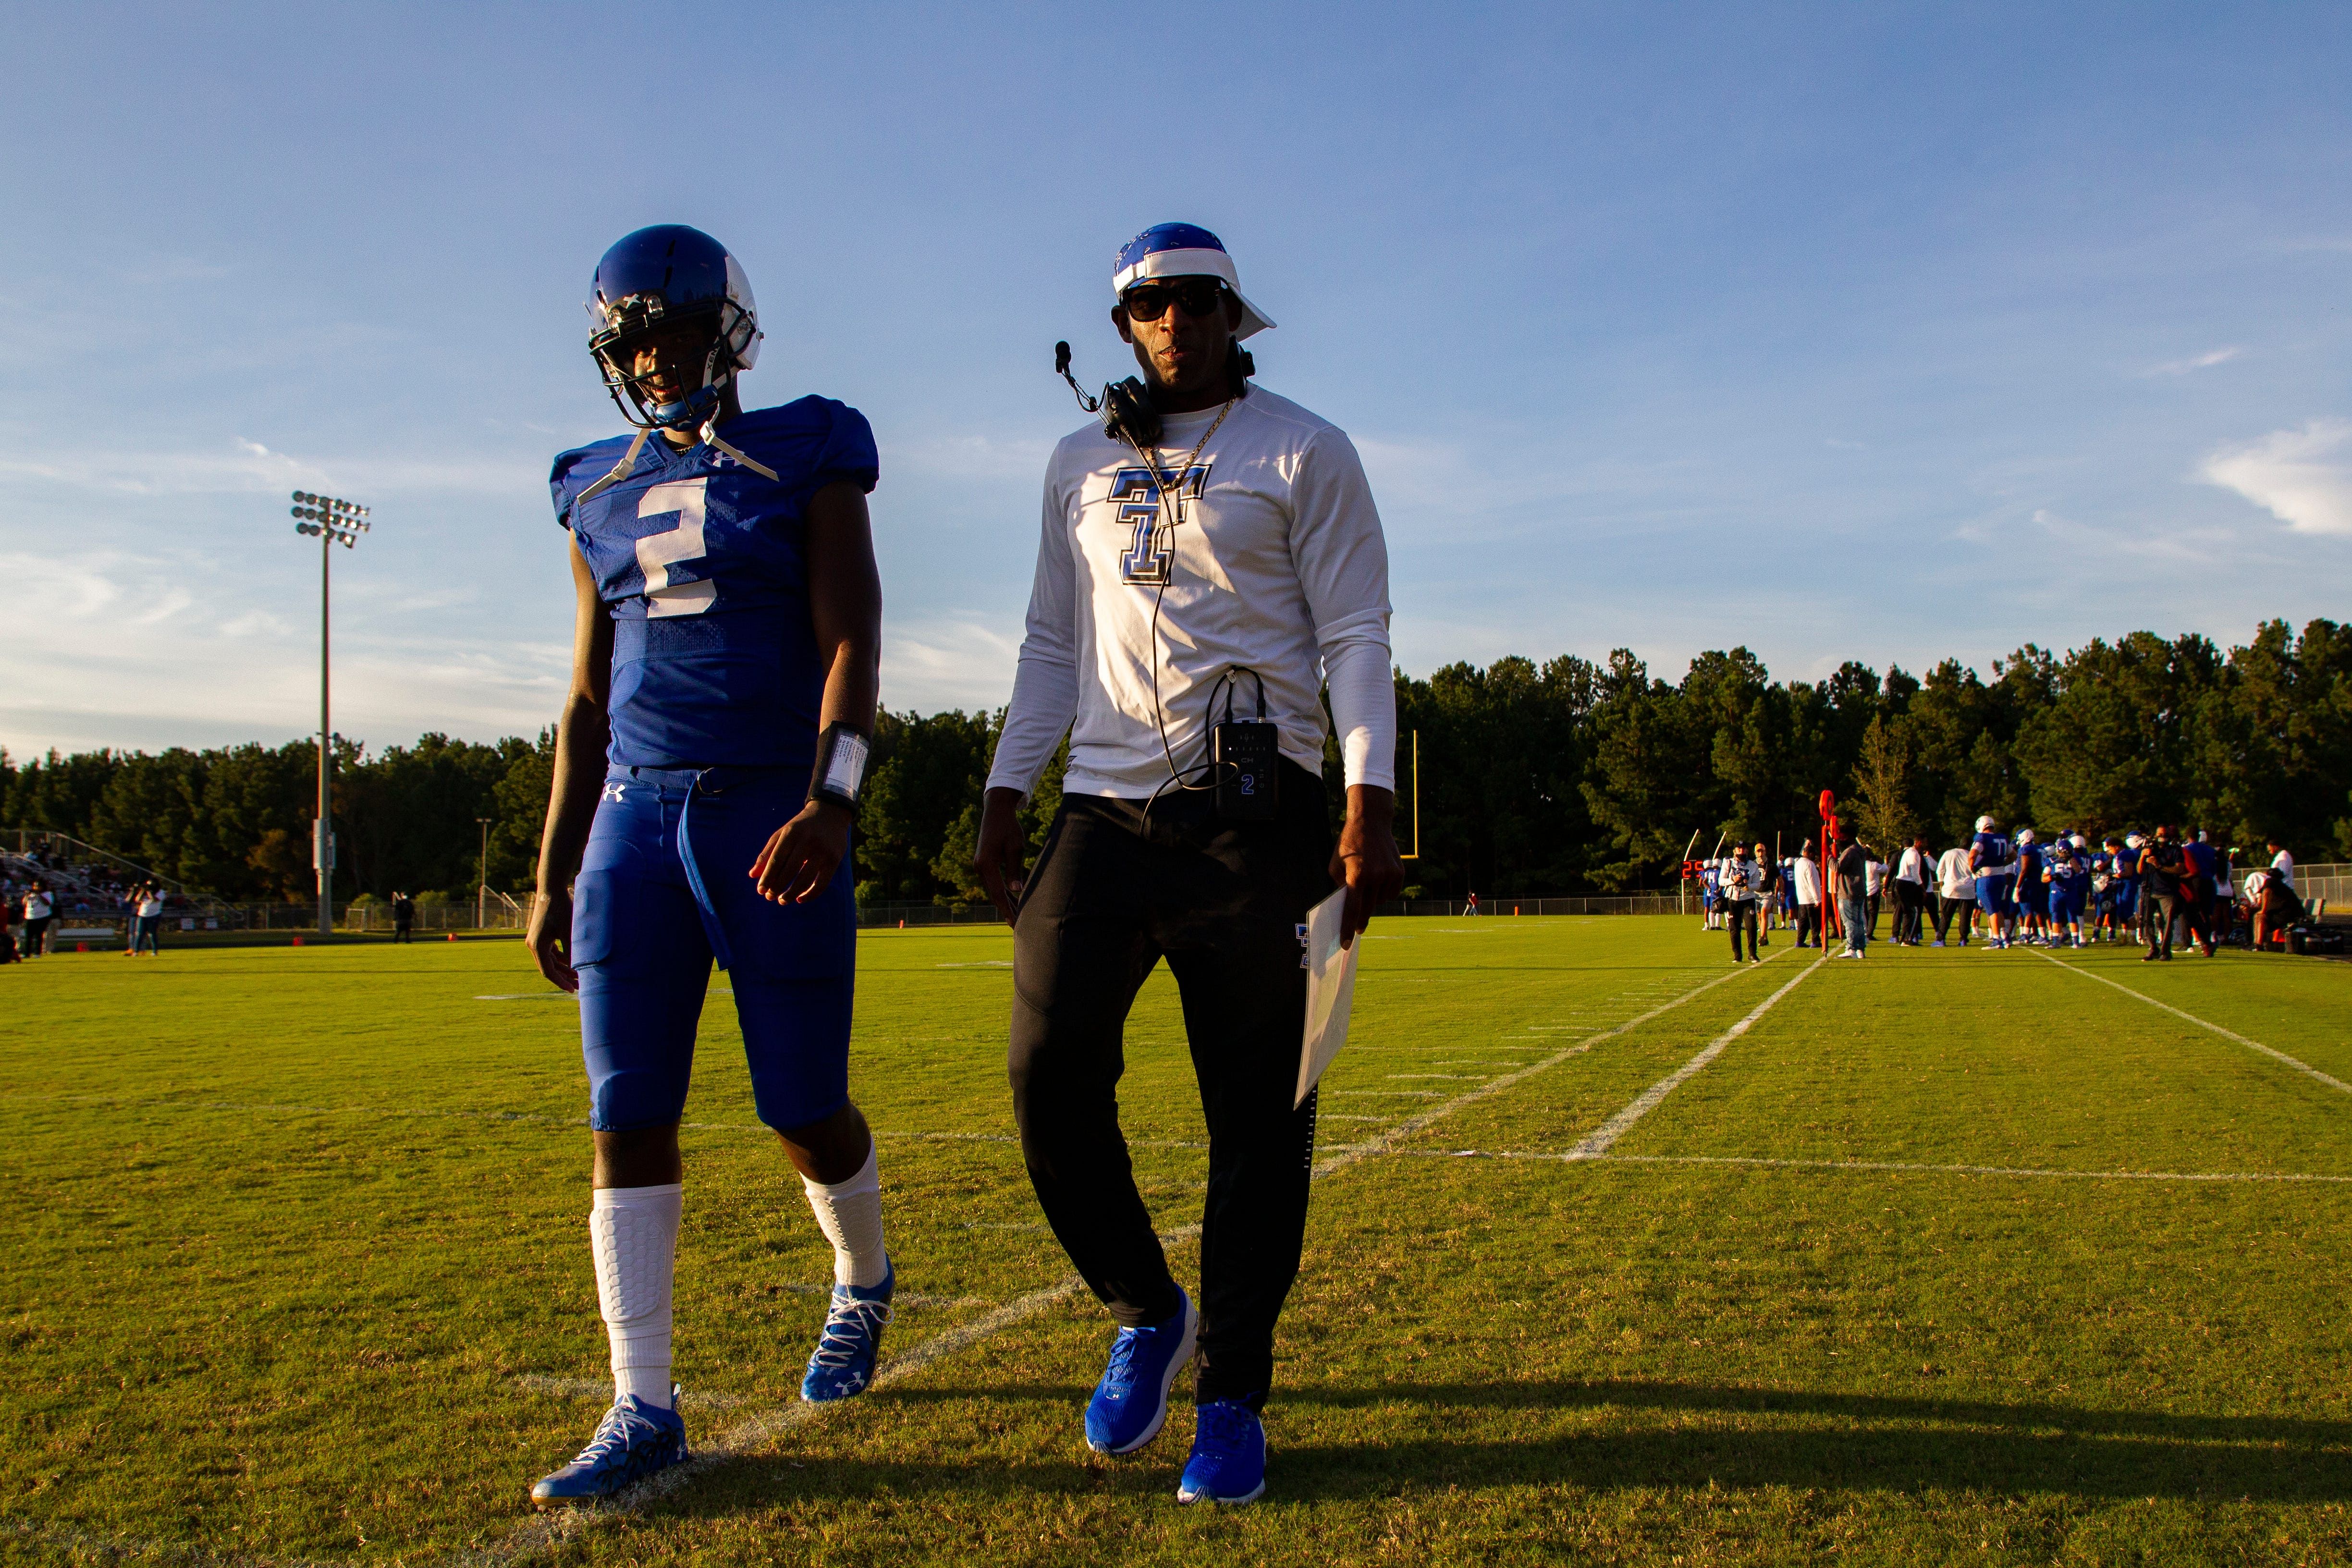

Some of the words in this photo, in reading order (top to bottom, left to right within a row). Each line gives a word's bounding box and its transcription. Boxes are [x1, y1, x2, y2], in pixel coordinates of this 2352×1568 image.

[636, 476, 717, 618] 2
[1241, 774, 1254, 795] 2
[1993, 838, 2008, 856] 77
[1682, 860, 1704, 879] 25
